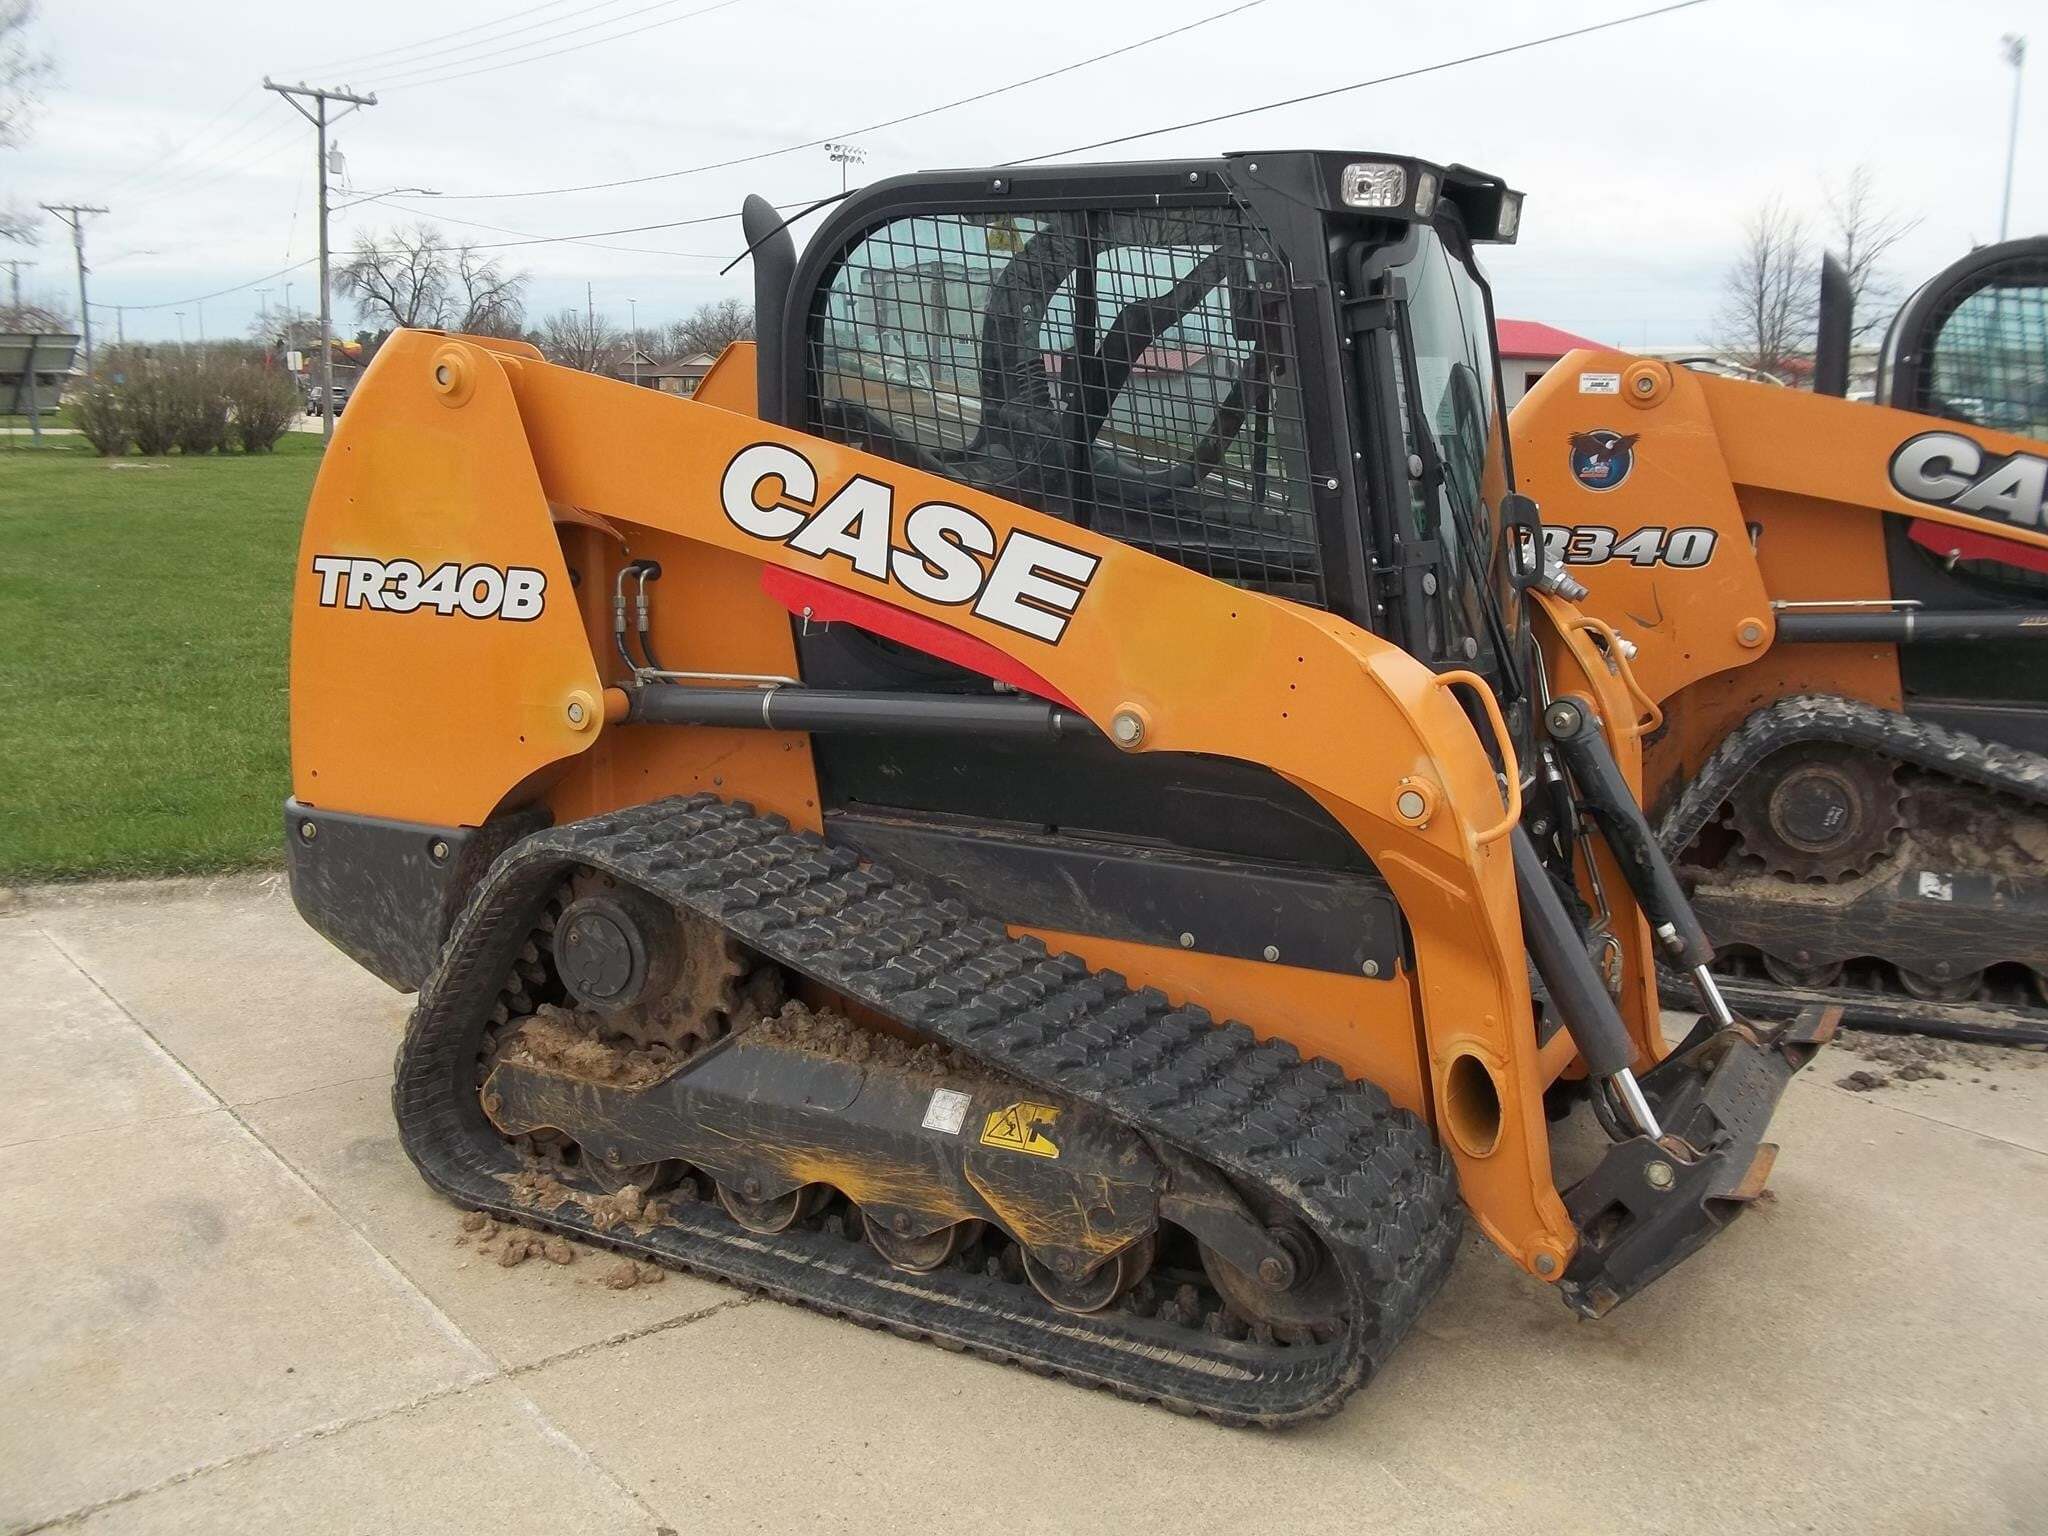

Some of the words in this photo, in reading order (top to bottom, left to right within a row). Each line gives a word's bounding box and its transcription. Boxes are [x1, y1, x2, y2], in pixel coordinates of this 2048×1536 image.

[1889, 431, 2048, 527] CA
[721, 442, 1102, 645] CASE
[1519, 525, 1718, 567] R340
[313, 555, 547, 622] TR340B
